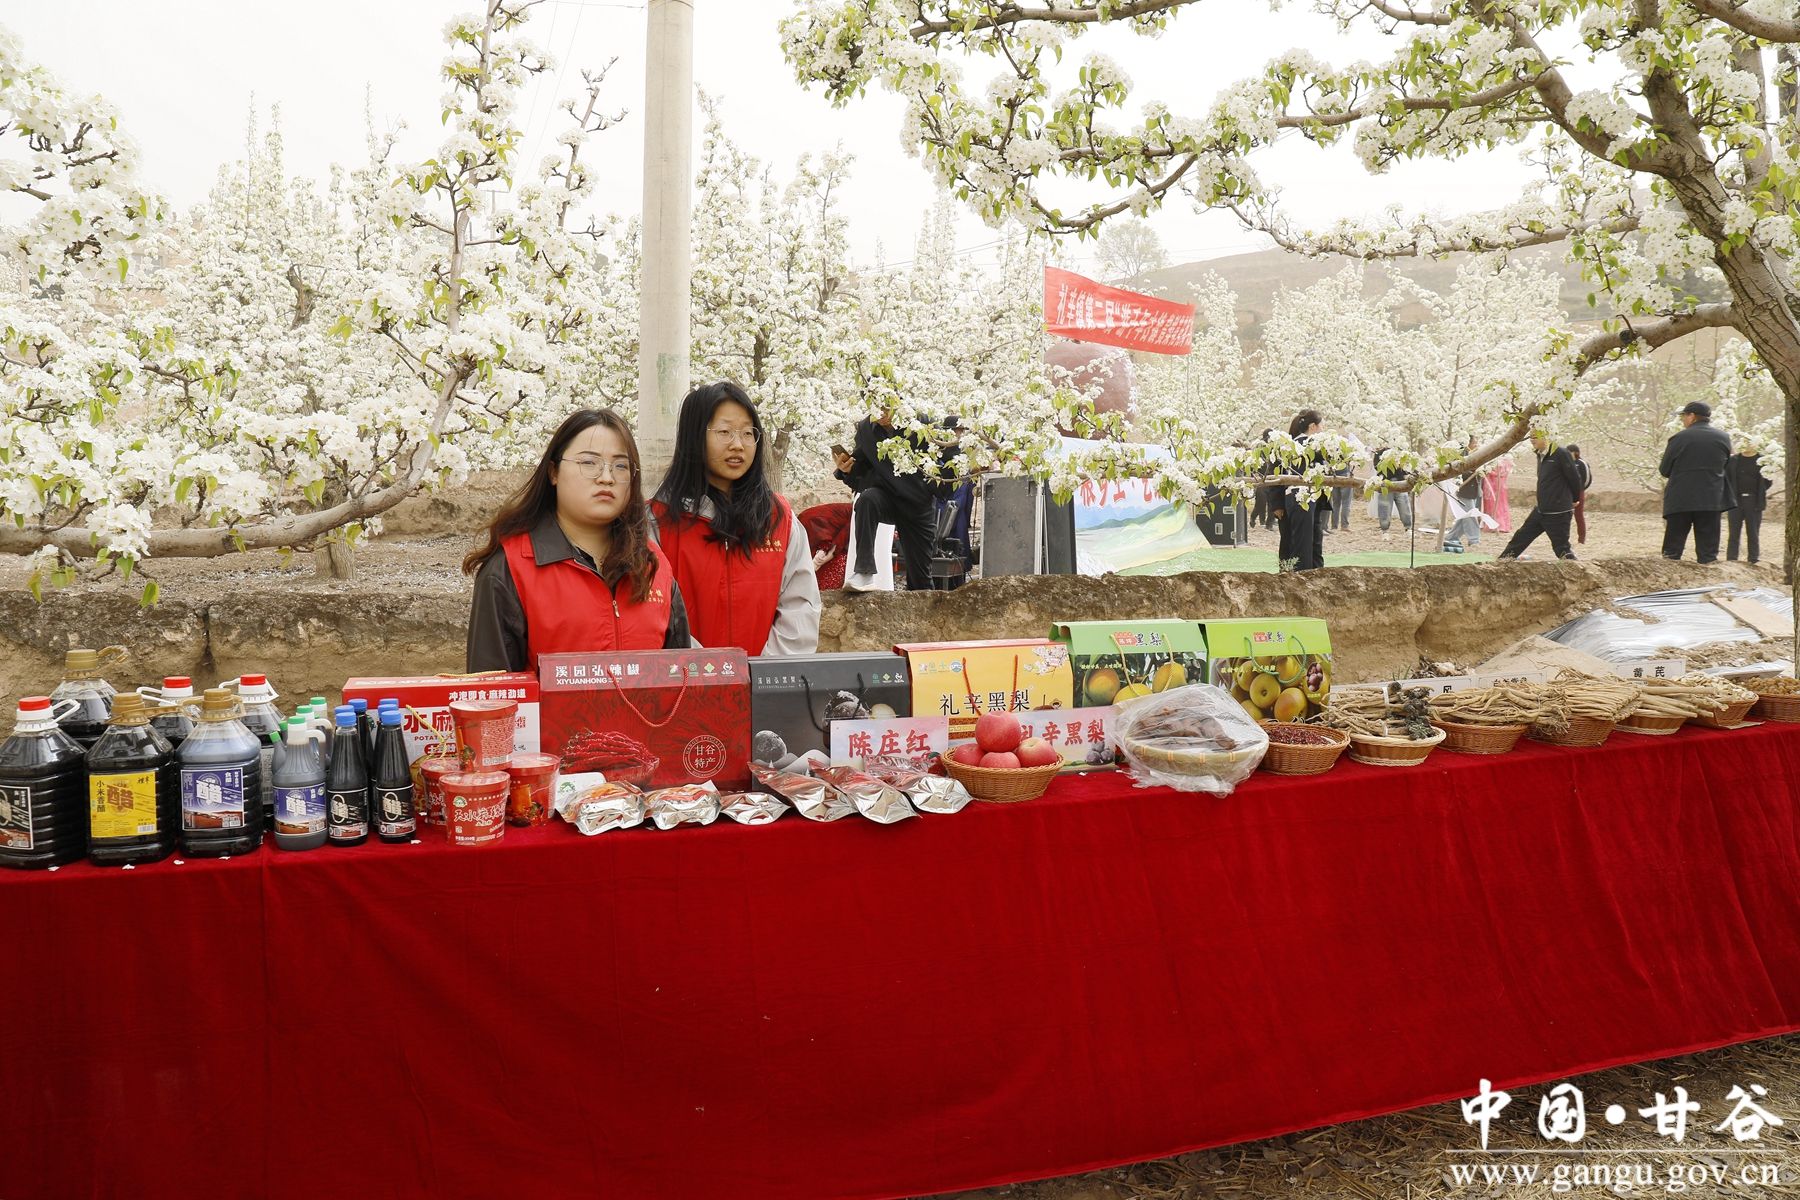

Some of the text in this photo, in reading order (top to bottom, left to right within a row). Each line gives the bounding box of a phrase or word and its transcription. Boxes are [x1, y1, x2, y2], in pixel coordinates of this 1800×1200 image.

[1633, 666, 1665, 678] 黄芪
[556, 677, 607, 685] XIYUANHONG
[939, 689, 1030, 716] 礼辛黑梨
[848, 729, 931, 758] 陈庄红
[695, 744, 716, 756] 甘谷
[694, 757, 716, 769] 特产
